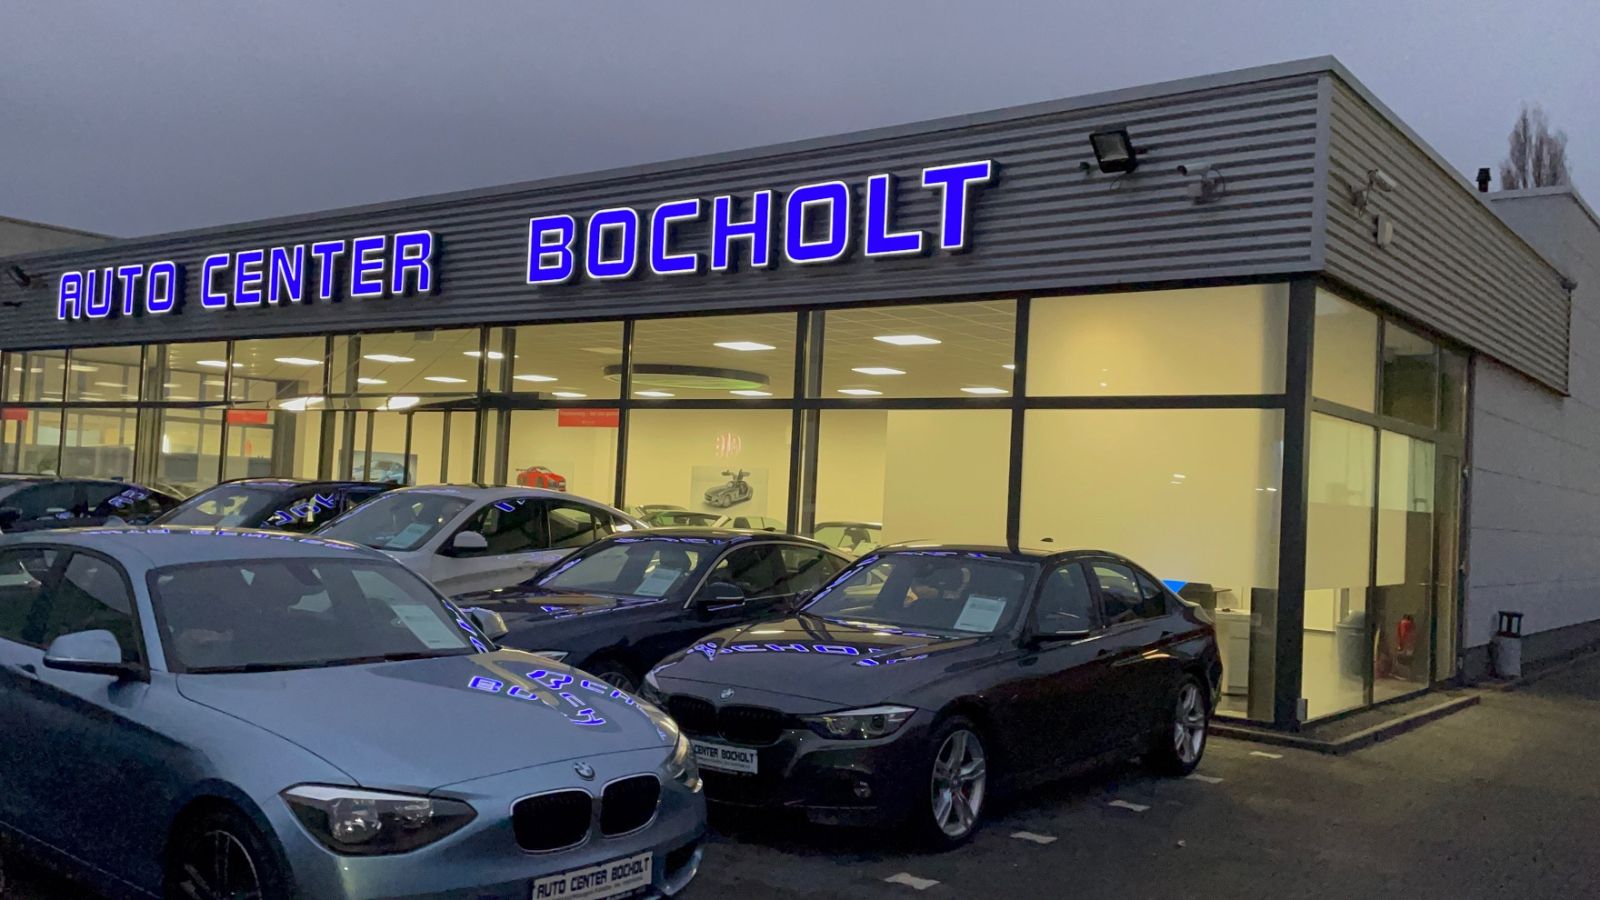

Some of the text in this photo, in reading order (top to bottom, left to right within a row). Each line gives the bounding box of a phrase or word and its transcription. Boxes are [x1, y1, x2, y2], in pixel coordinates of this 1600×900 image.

[57, 159, 992, 320] AUTO CENTER BOCHOLT
[694, 744, 718, 758] CENTER
[721, 749, 754, 763] BOCHOLT
[537, 879, 566, 899] AUTO
[570, 869, 607, 892] CENTER
[611, 857, 650, 881] BOCHOLT
